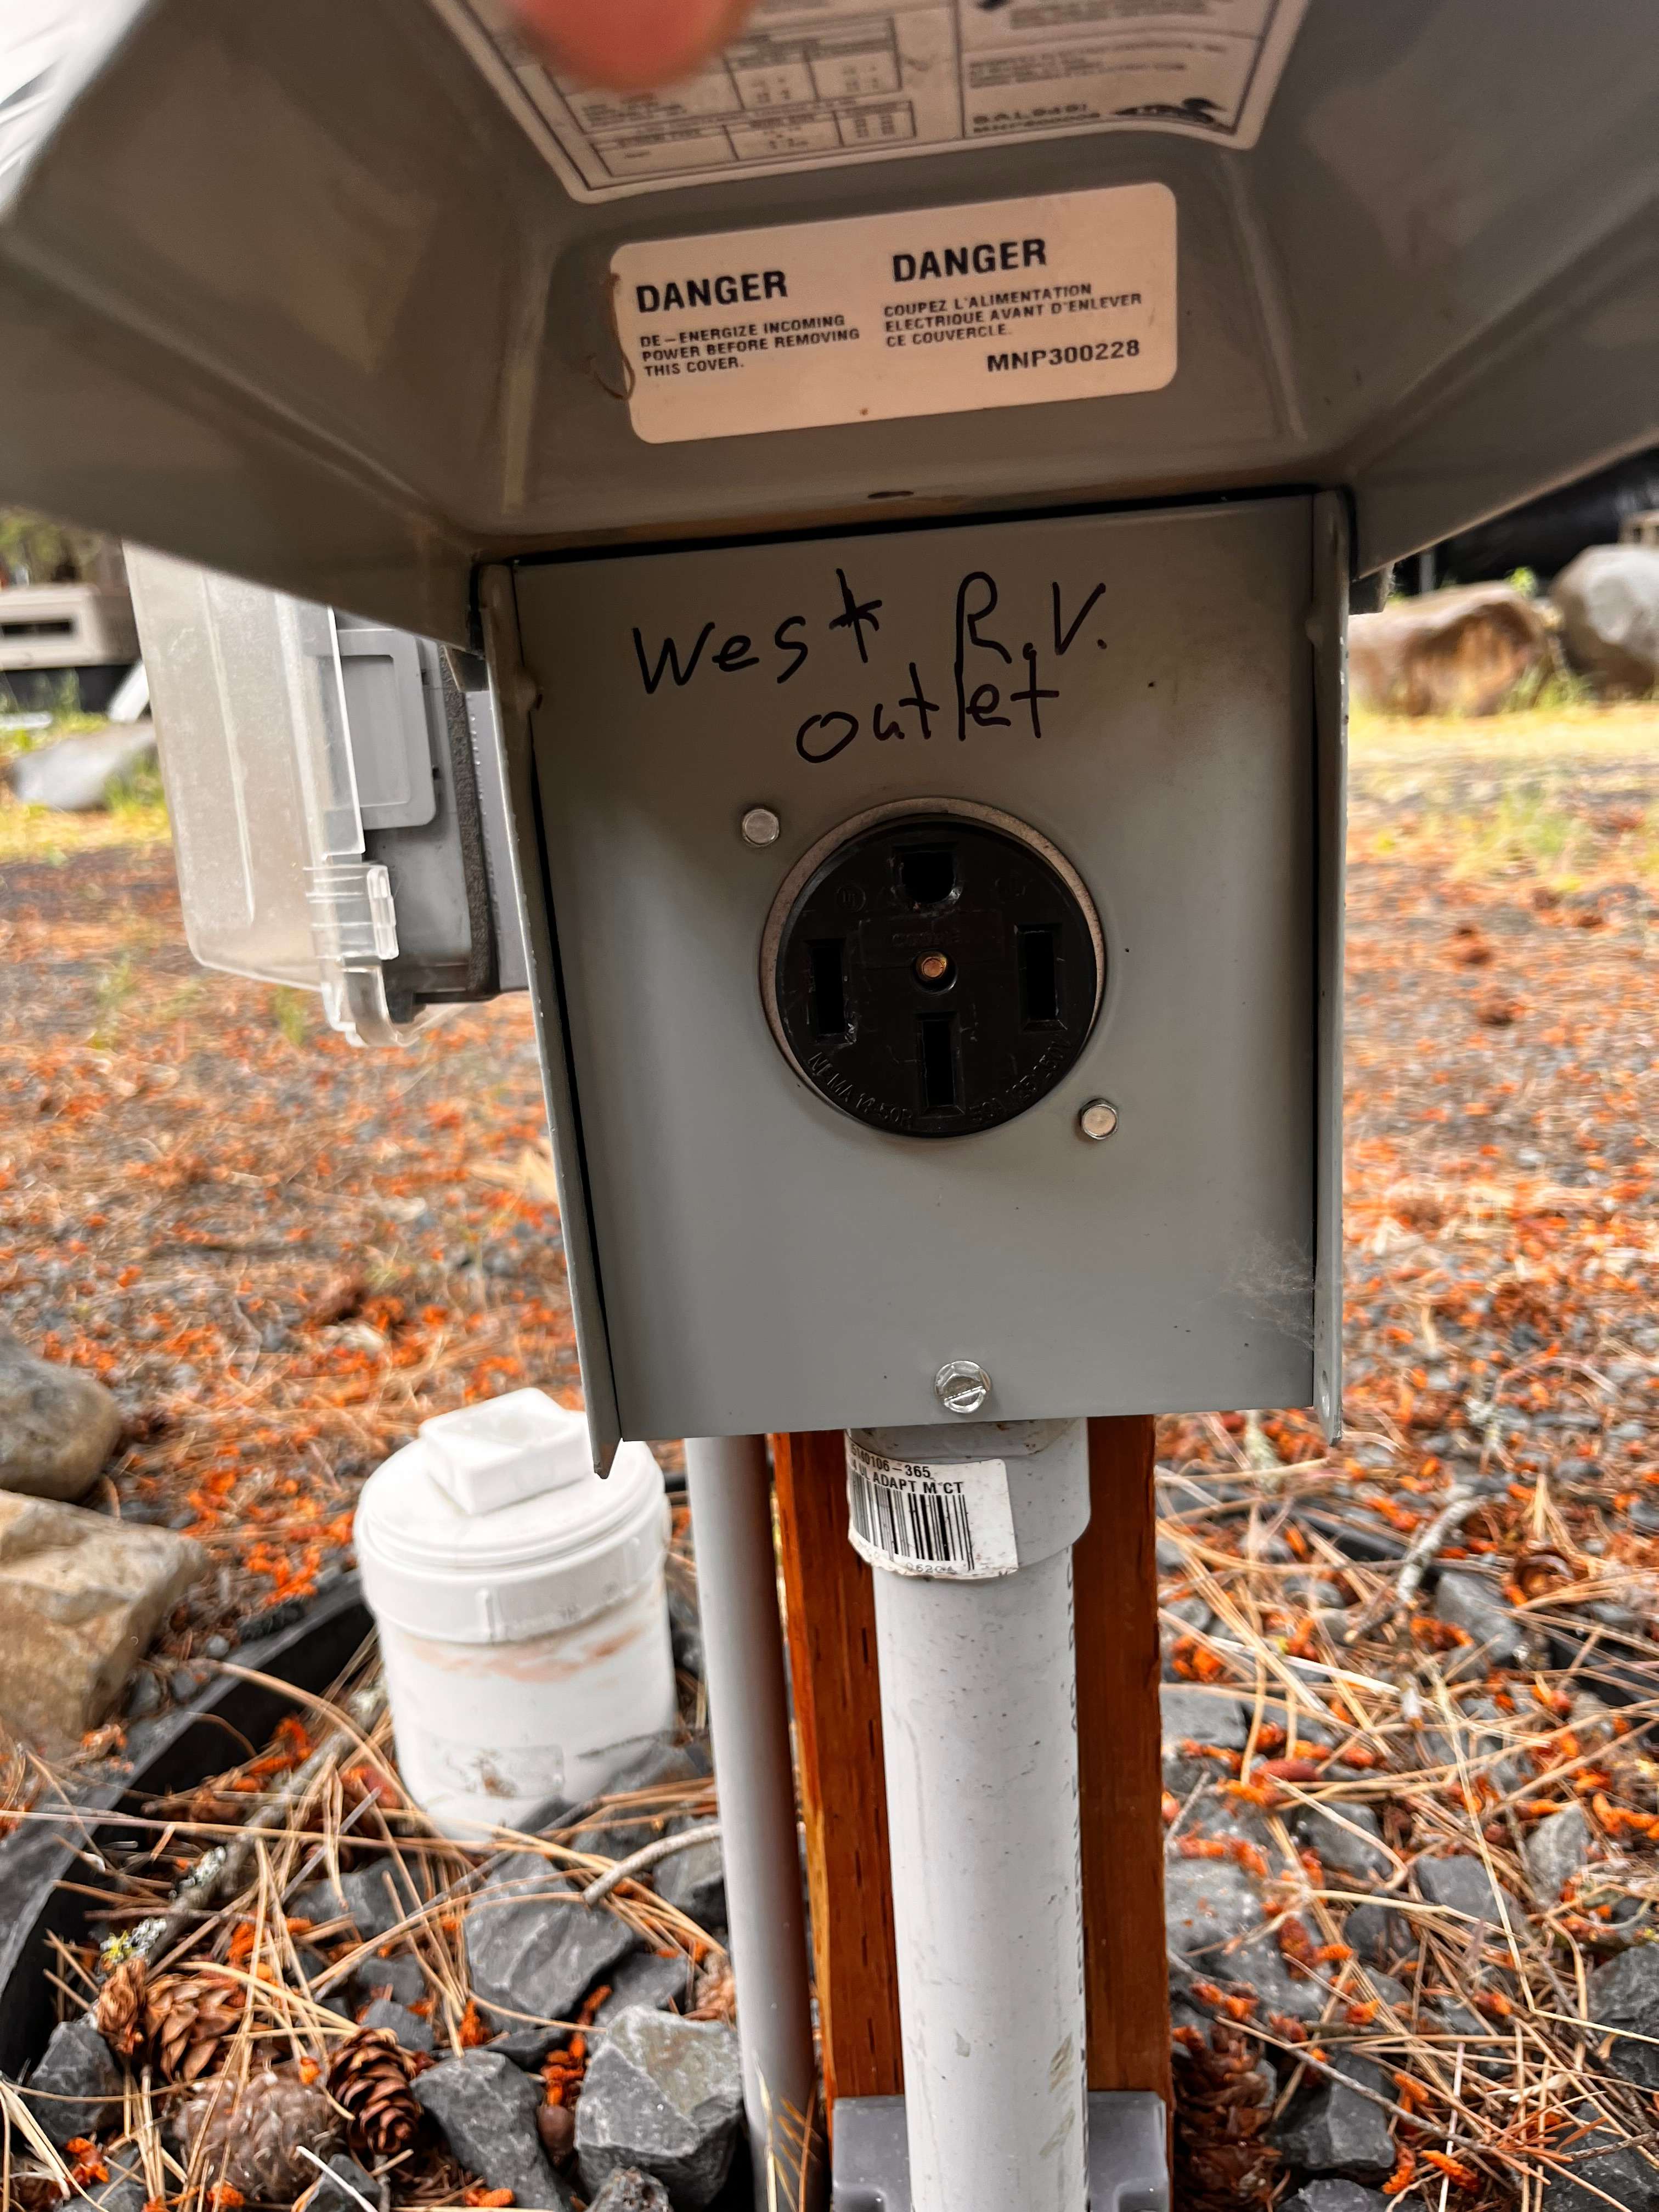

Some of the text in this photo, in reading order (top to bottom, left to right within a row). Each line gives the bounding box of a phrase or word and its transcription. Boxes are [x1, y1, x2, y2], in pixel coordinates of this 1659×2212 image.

[892, 238, 1047, 282] DANGER
[636, 270, 788, 313] DANGER
[883, 283, 1092, 318] COUPEZ L'ALIMENTATION
[764, 314, 845, 334] INCOMING
[885, 292, 1142, 333] ELECTRIQUE AVANT D'ENLEVER
[642, 328, 860, 362] POWER BEFORE REMOVING
[886, 335, 906, 348] CE
[986, 339, 1141, 372] MNP300228
[644, 357, 745, 377] THIS COVER.
[632, 568, 883, 695] West
[795, 653, 1060, 764] outlet
[873, 1471, 917, 1493] ADAPT
[943, 1481, 964, 1494] CT
